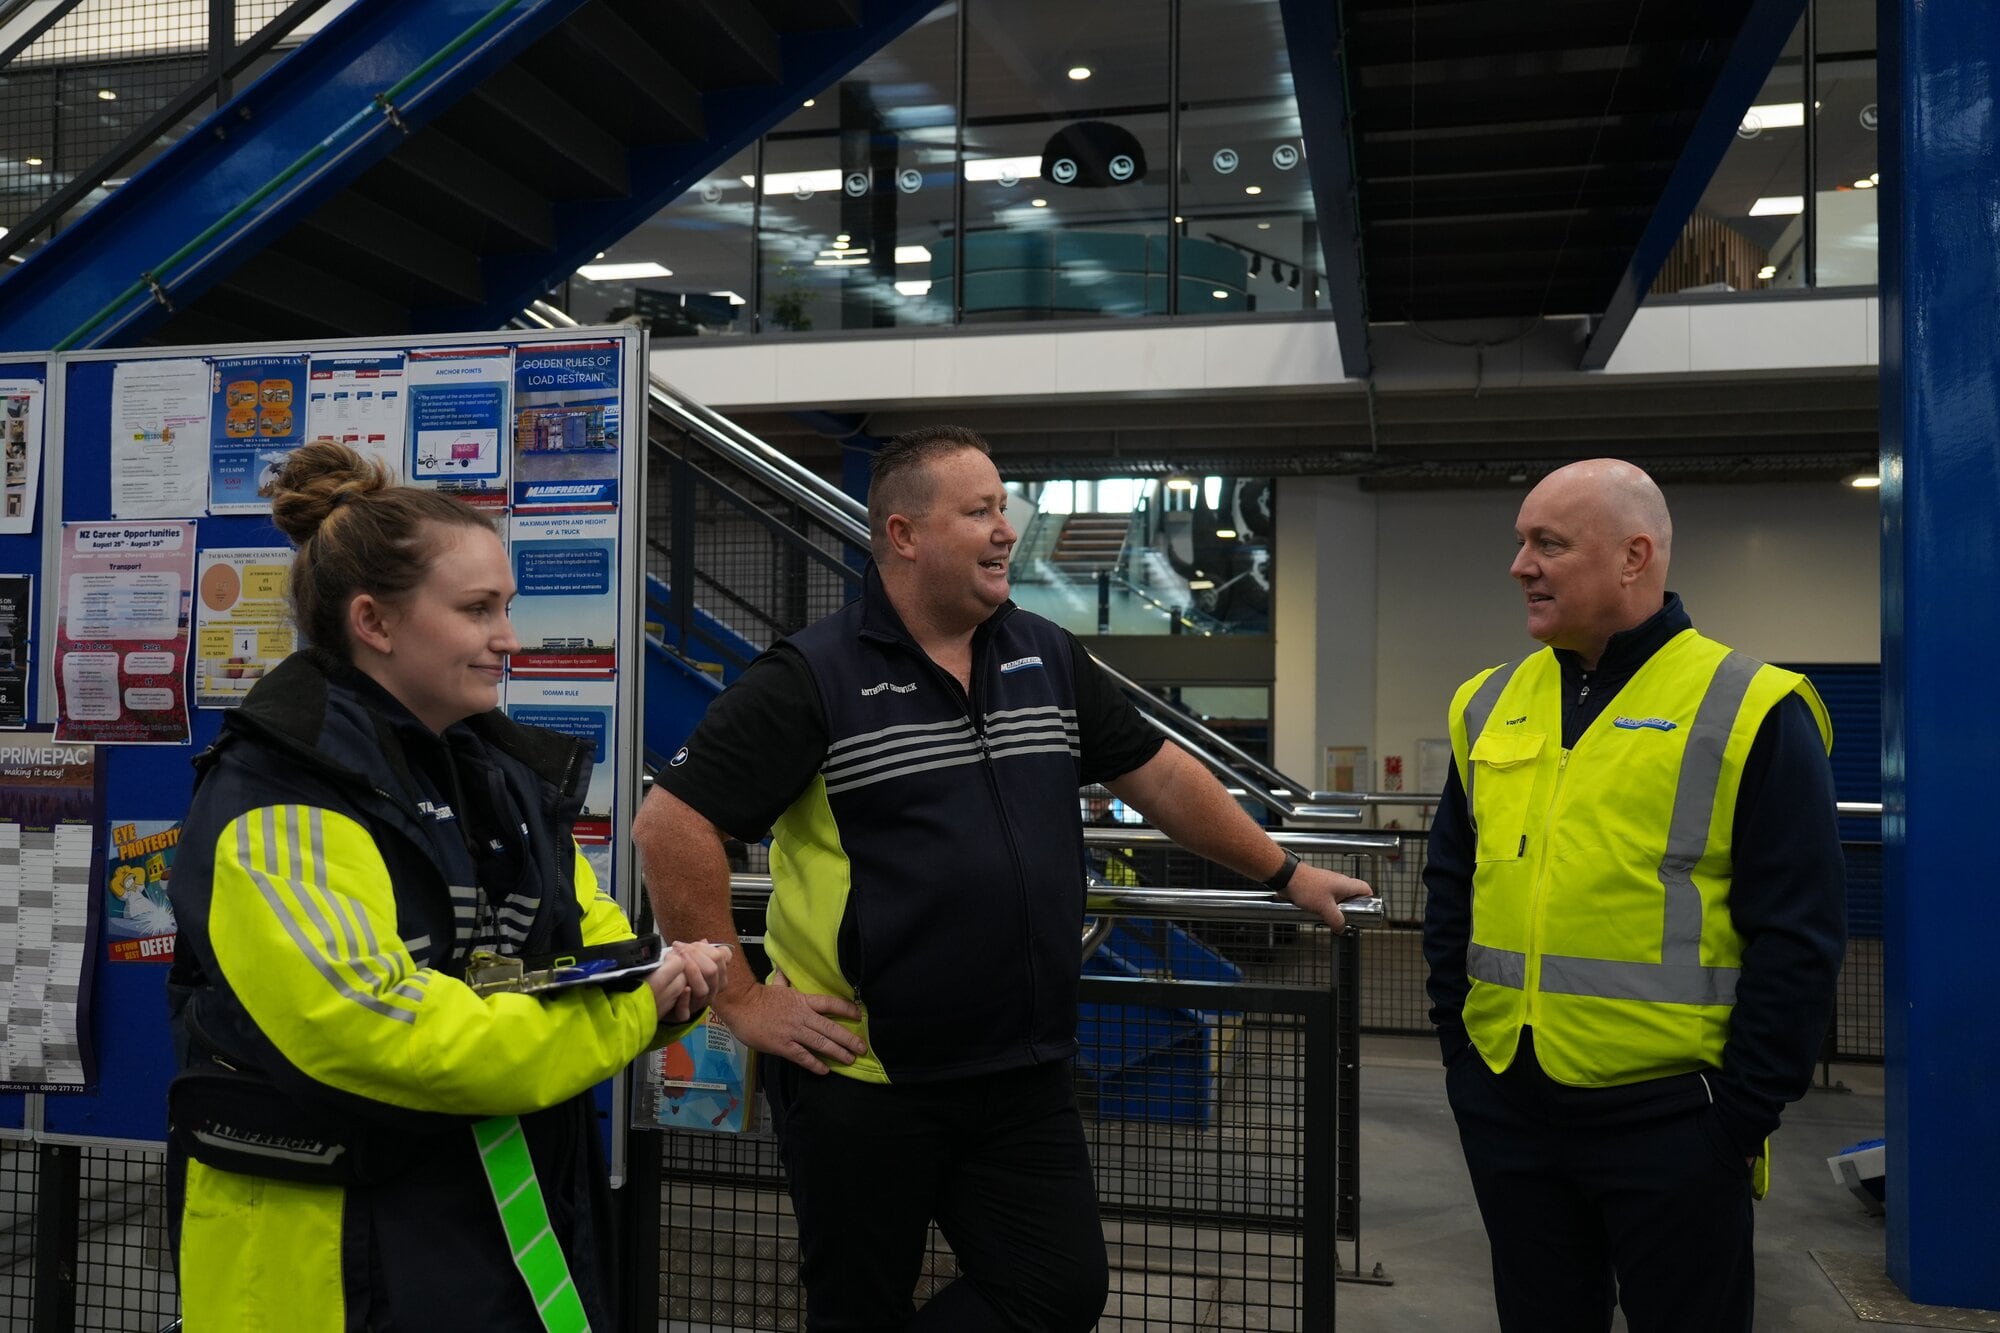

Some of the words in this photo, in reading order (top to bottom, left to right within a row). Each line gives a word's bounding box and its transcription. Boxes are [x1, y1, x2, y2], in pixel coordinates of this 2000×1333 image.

[523, 359, 563, 369] GOLDEN
[566, 358, 594, 368] RULES
[597, 356, 611, 366] OF
[529, 375, 554, 385] LOAD
[557, 373, 605, 384] RESTRAINT
[525, 485, 604, 497] MAINFREIGHT
[93, 530, 121, 538] Career
[124, 529, 180, 539] Opportunities
[241, 639, 248, 650] 4
[861, 682, 889, 696] ANTHONY
[1506, 716, 1527, 726] VISITOR
[0, 747, 88, 765] PRIMEPAC
[4, 768, 31, 778] making
[34, 768, 41, 776] it
[43, 769, 65, 779] easy!
[112, 822, 137, 846] EYE
[118, 827, 181, 861] PROTECTI
[115, 944, 121, 953] IS
[122, 942, 139, 952] YOUR
[125, 951, 140, 960] BEST
